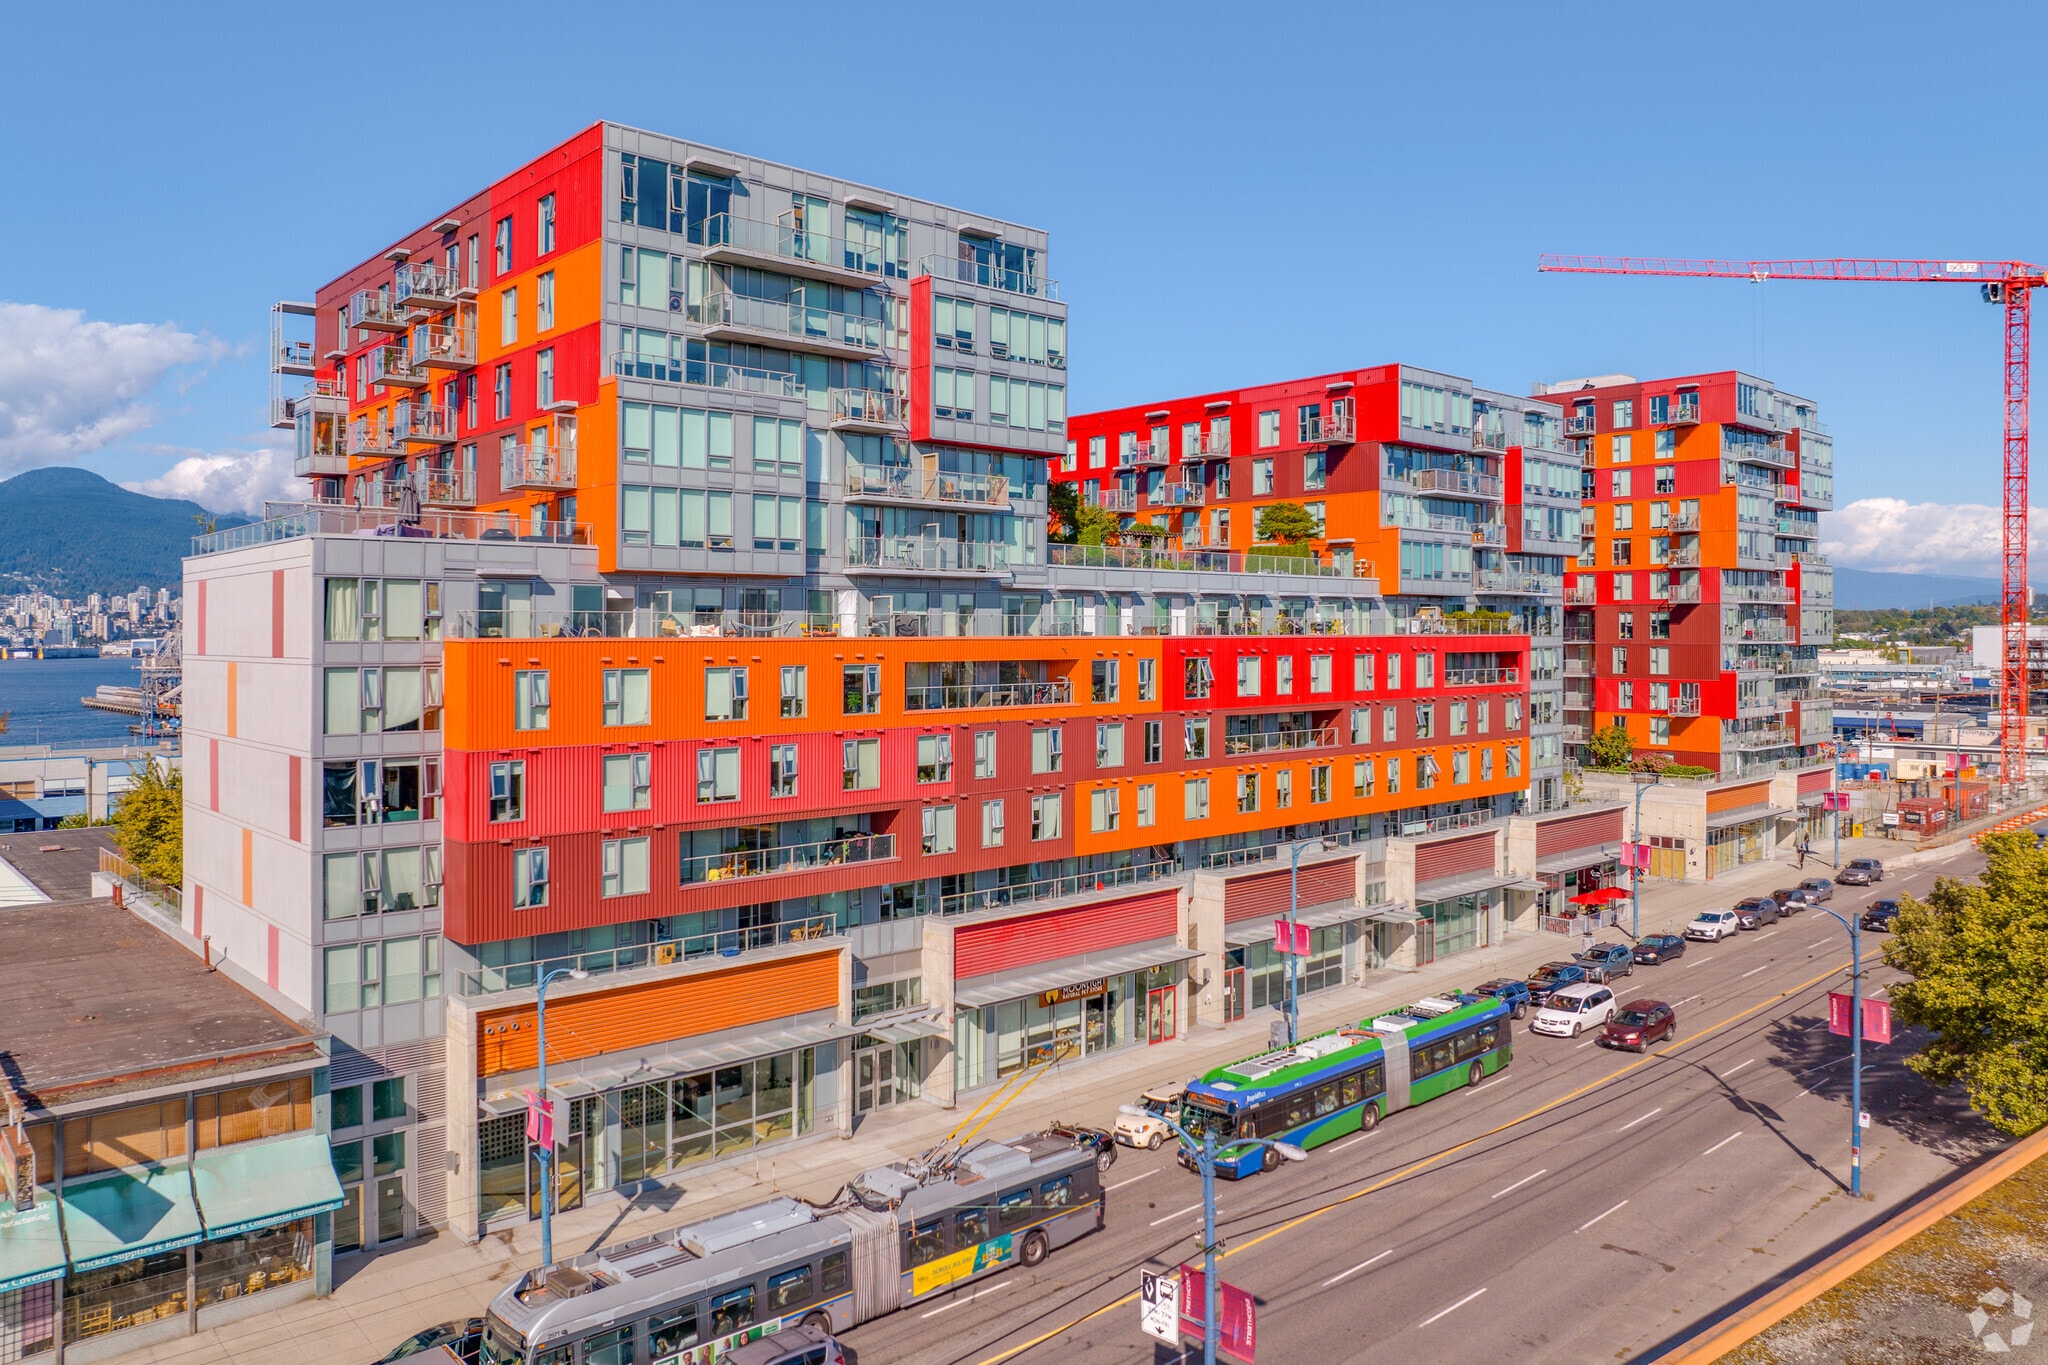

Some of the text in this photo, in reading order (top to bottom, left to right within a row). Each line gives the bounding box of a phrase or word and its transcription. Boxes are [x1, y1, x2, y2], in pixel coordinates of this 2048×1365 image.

[1062, 978, 1105, 993] MOONLIGHT
[1062, 984, 1103, 1000] NATURAL PET STORE
[215, 1225, 239, 1236] Home
[248, 1213, 291, 1228] Commercial
[293, 1203, 335, 1217] Furnishings
[77, 1235, 199, 1269] Wicker Supplies & Repairs
[932, 1265, 951, 1275] SCROLL
[953, 1260, 961, 1268] ALL
[962, 1255, 972, 1264] DAY
[11, 1268, 63, 1286] Coverings
[1245, 1298, 1253, 1346] STRATHCONA
[547, 1331, 560, 1340] 2571
